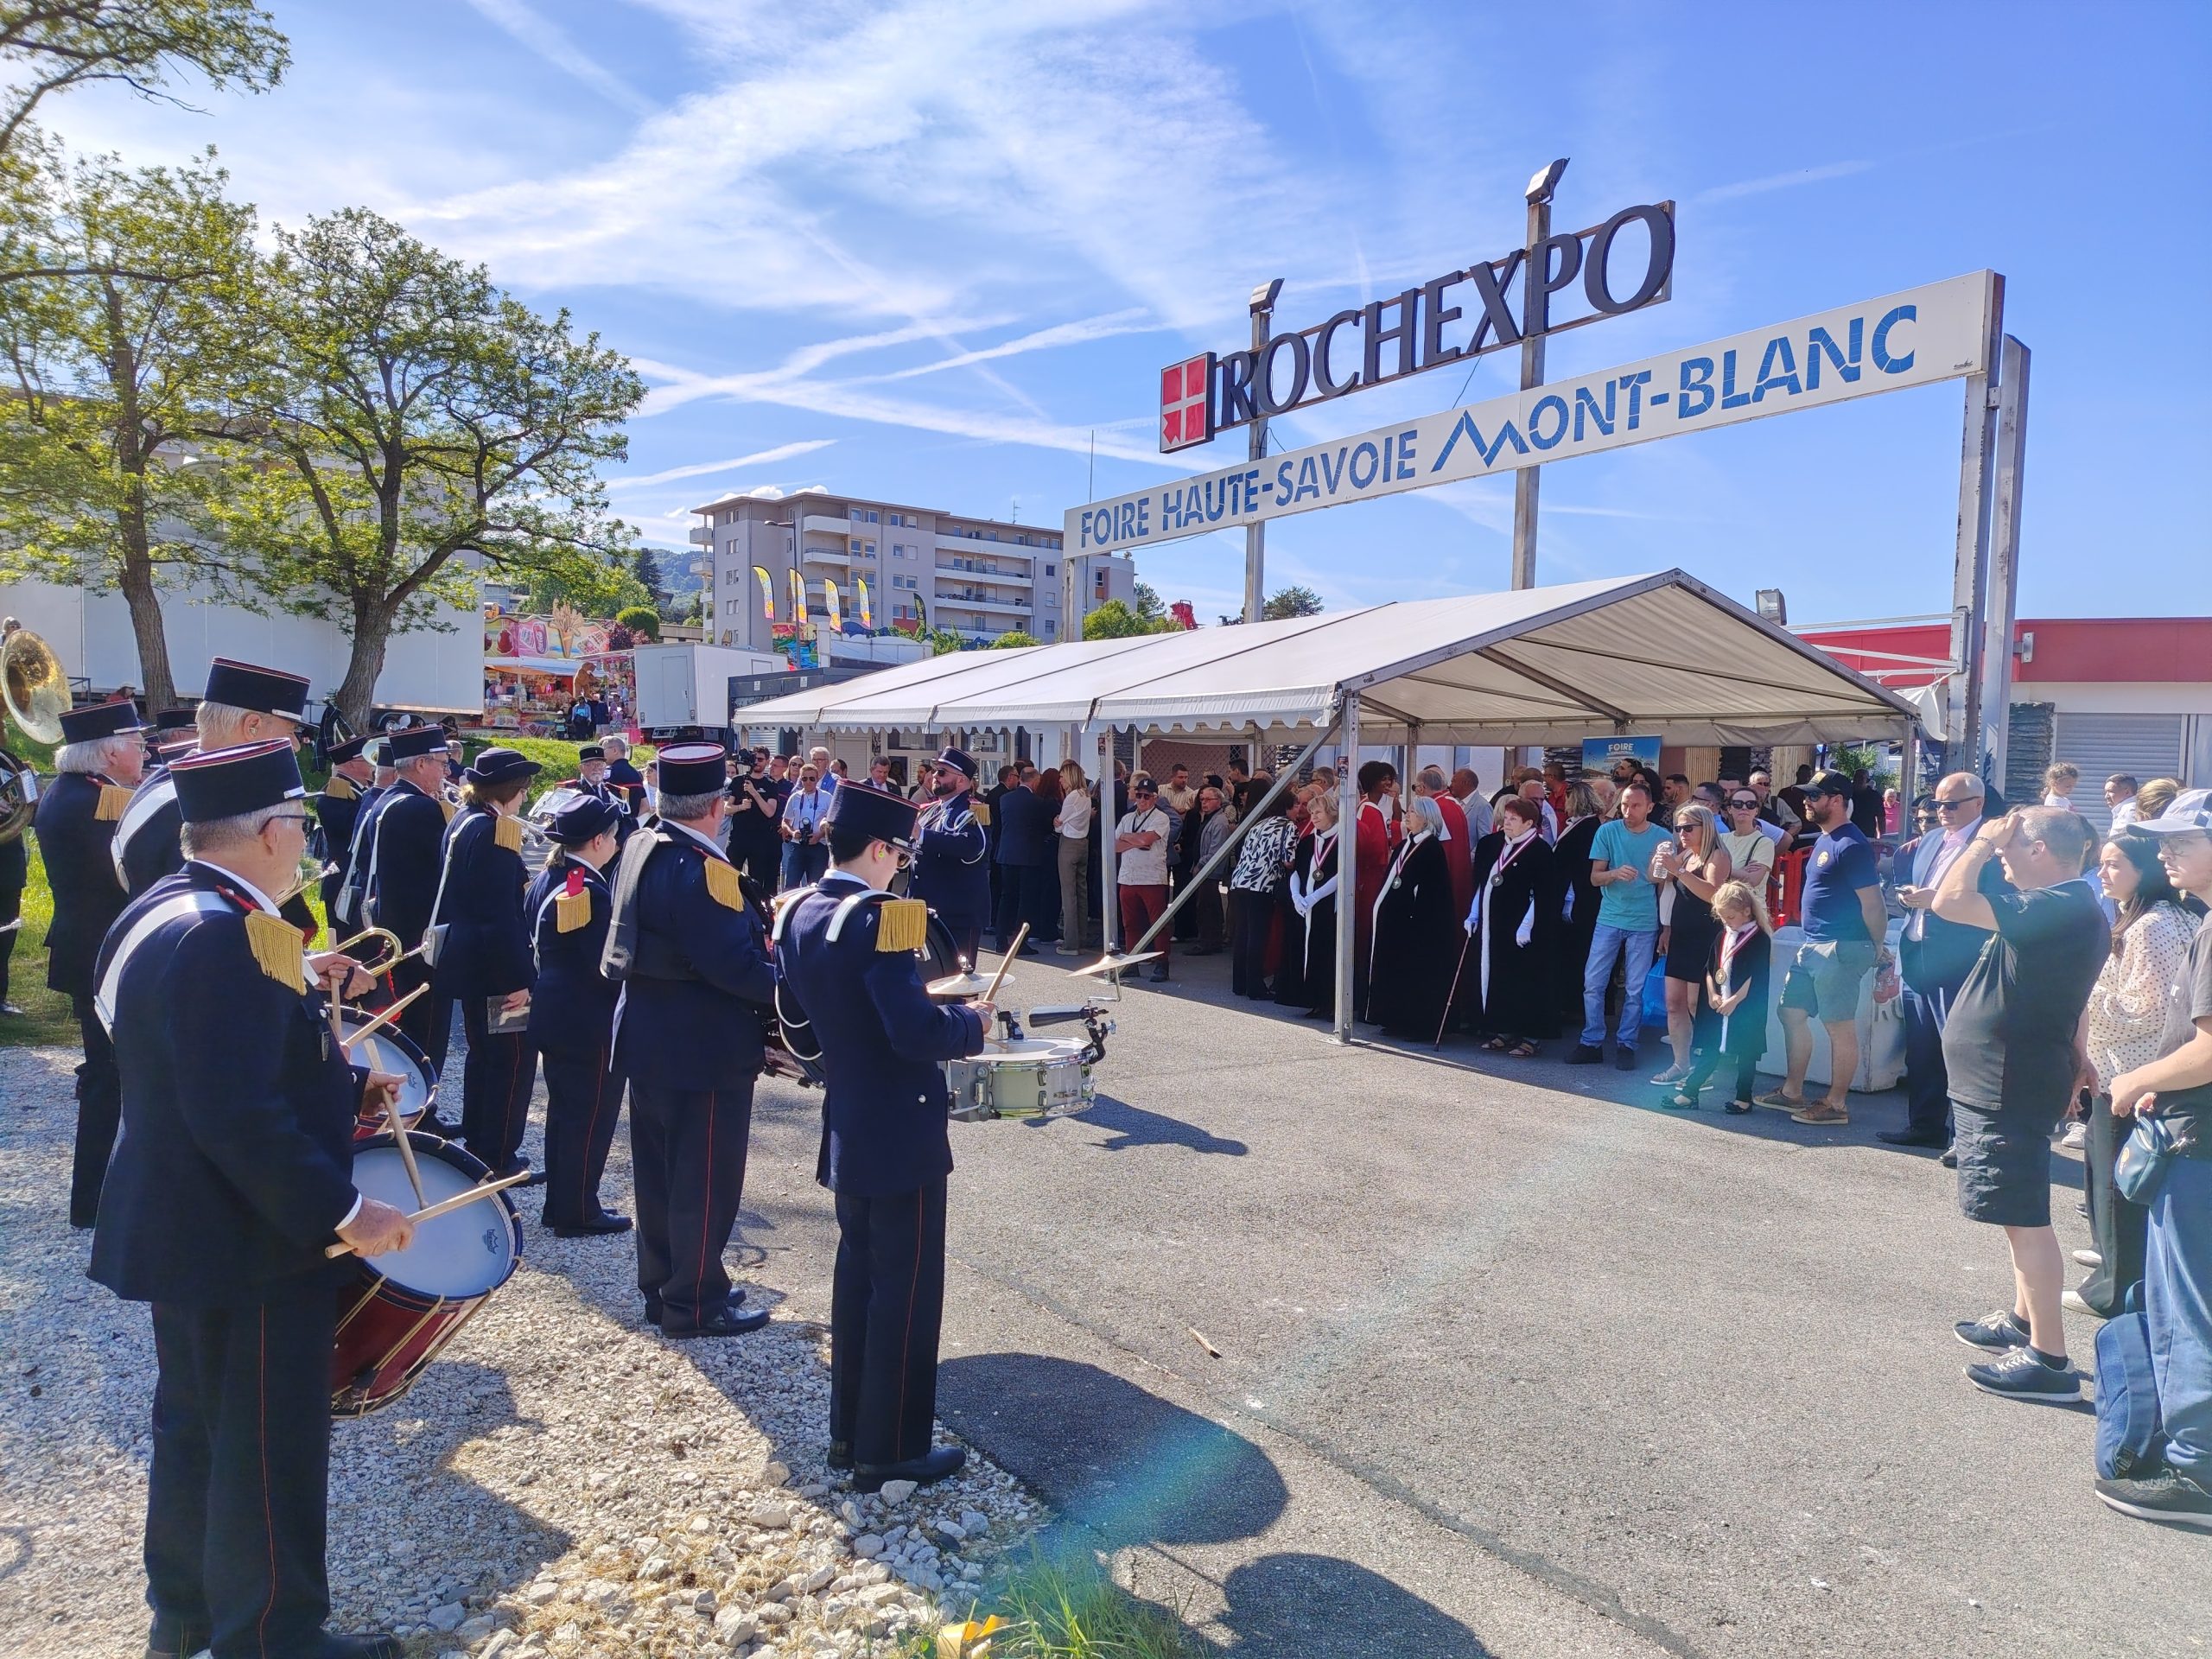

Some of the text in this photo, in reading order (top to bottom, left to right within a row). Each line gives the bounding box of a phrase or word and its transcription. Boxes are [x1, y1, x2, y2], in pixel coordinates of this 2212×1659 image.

[1081, 304, 1916, 549] FOIRE HAUTE-SAVOIE MONT-BLANC
[1221, 205, 1675, 427] ROCHEXPO
[1608, 743, 1634, 752] FOIRE
